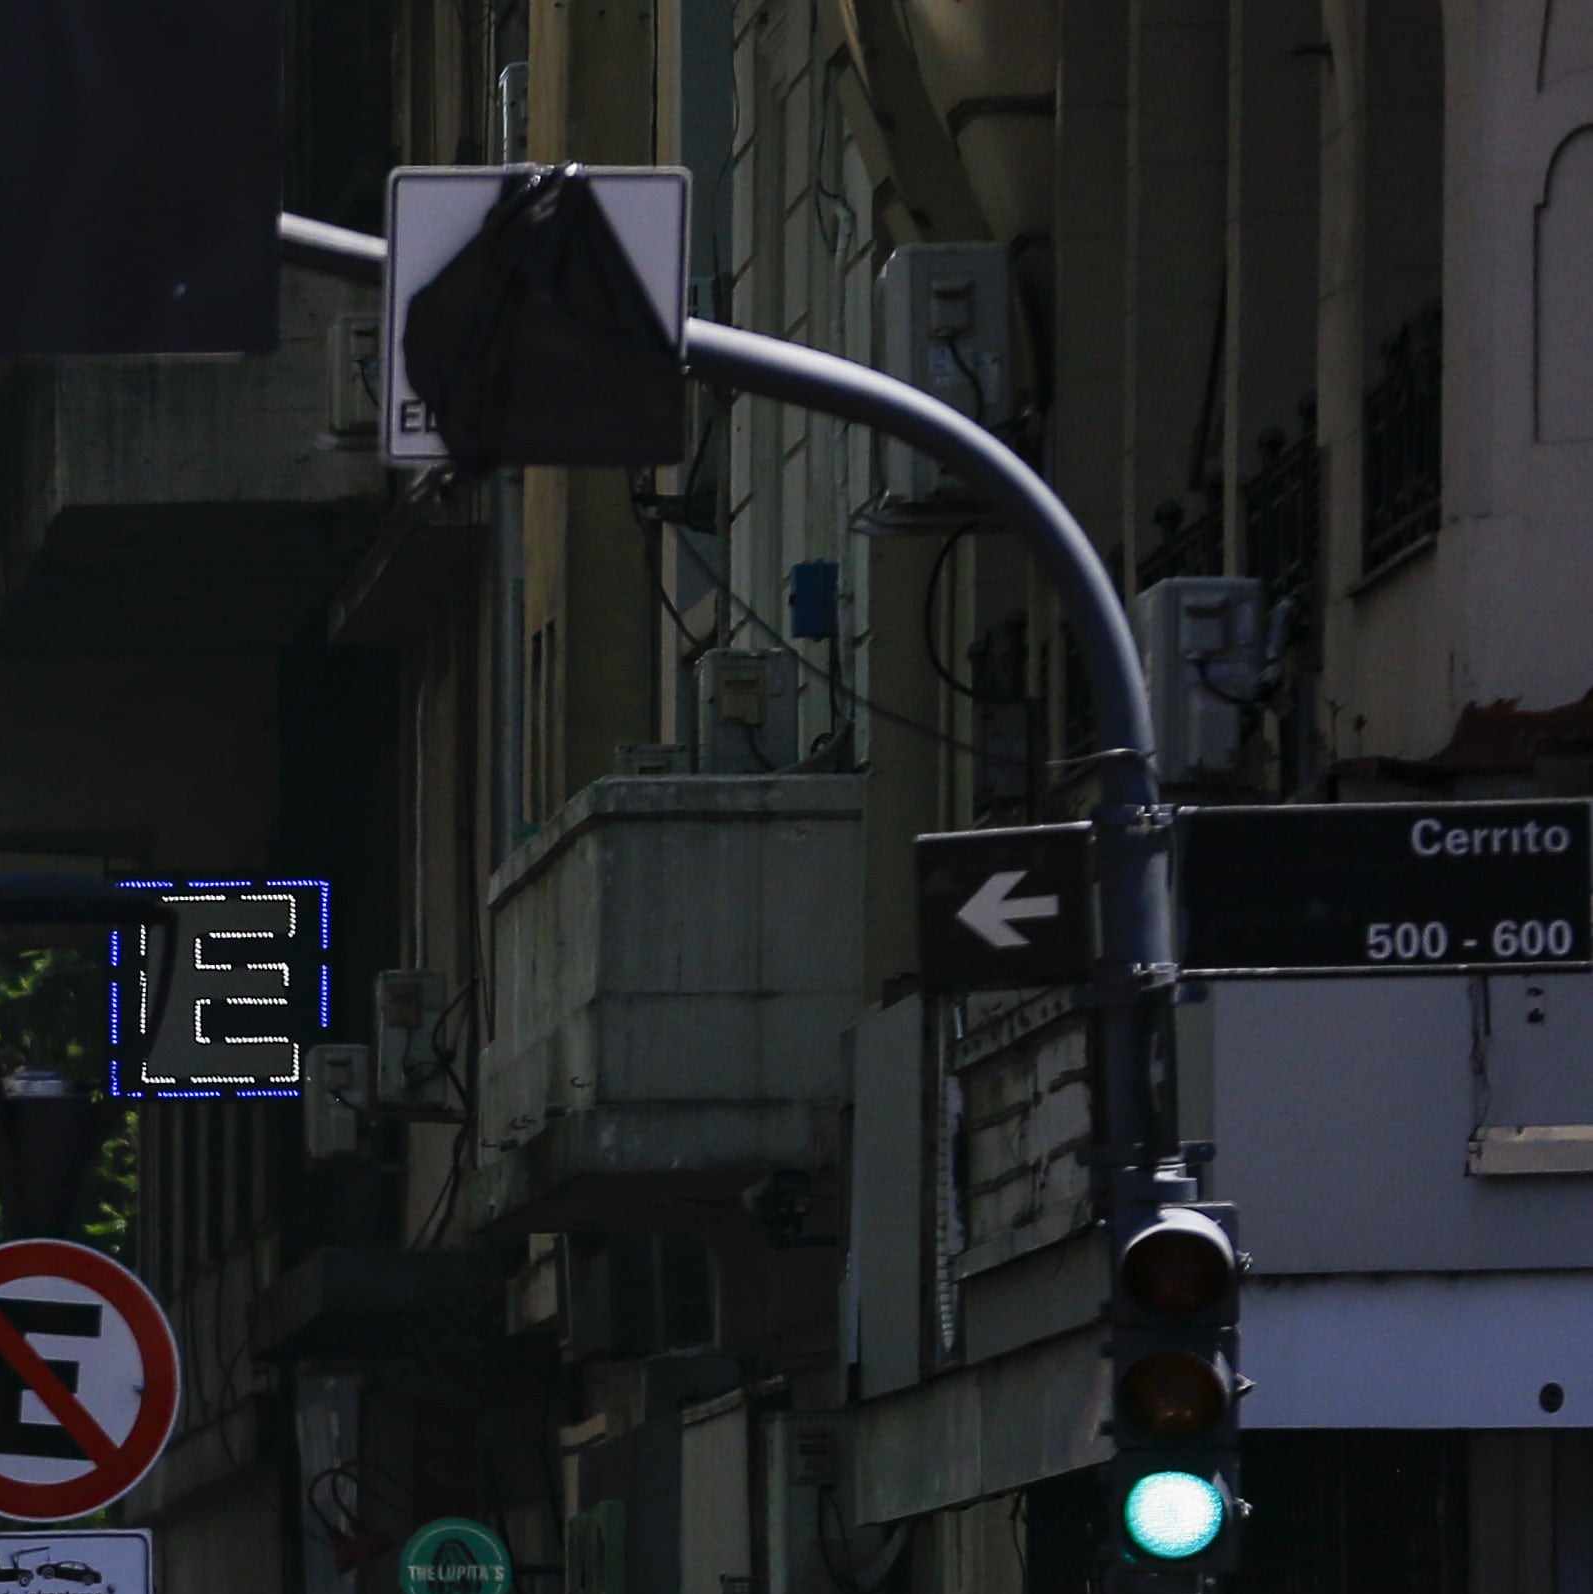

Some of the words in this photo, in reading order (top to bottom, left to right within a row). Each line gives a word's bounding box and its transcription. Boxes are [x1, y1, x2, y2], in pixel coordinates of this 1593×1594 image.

[1411, 817, 1571, 857] Cerrito
[1366, 921, 1449, 960] 500
[1491, 918, 1573, 957] 600
